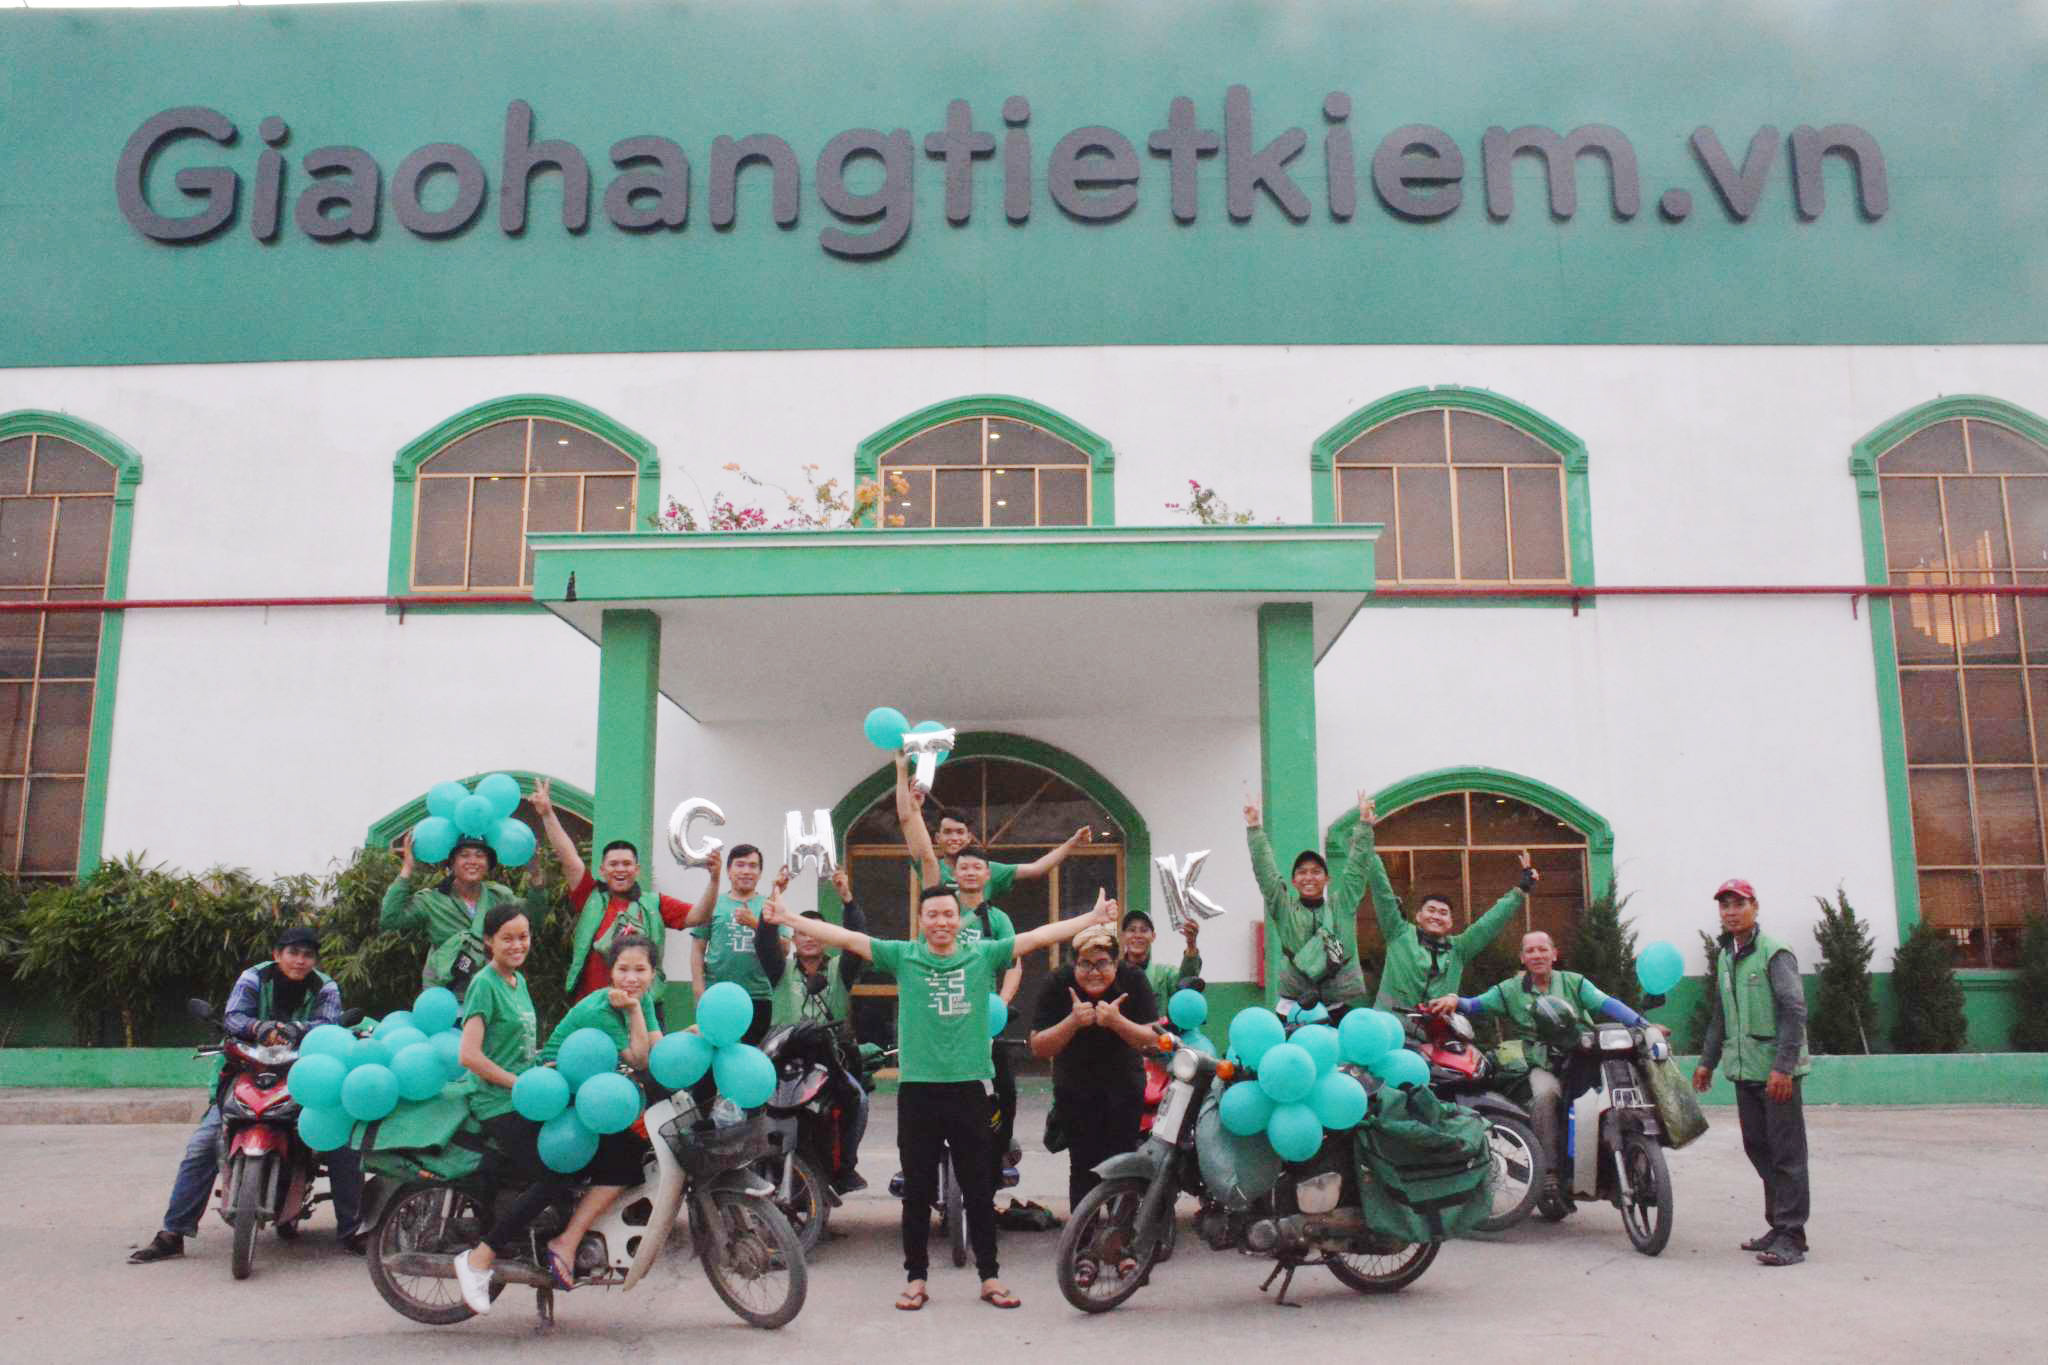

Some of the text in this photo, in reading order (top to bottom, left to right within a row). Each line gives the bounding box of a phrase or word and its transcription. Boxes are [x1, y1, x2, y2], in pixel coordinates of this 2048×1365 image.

[115, 85, 1888, 261] Giaohangtietkiem.vn
[668, 728, 1226, 931] G H T K
